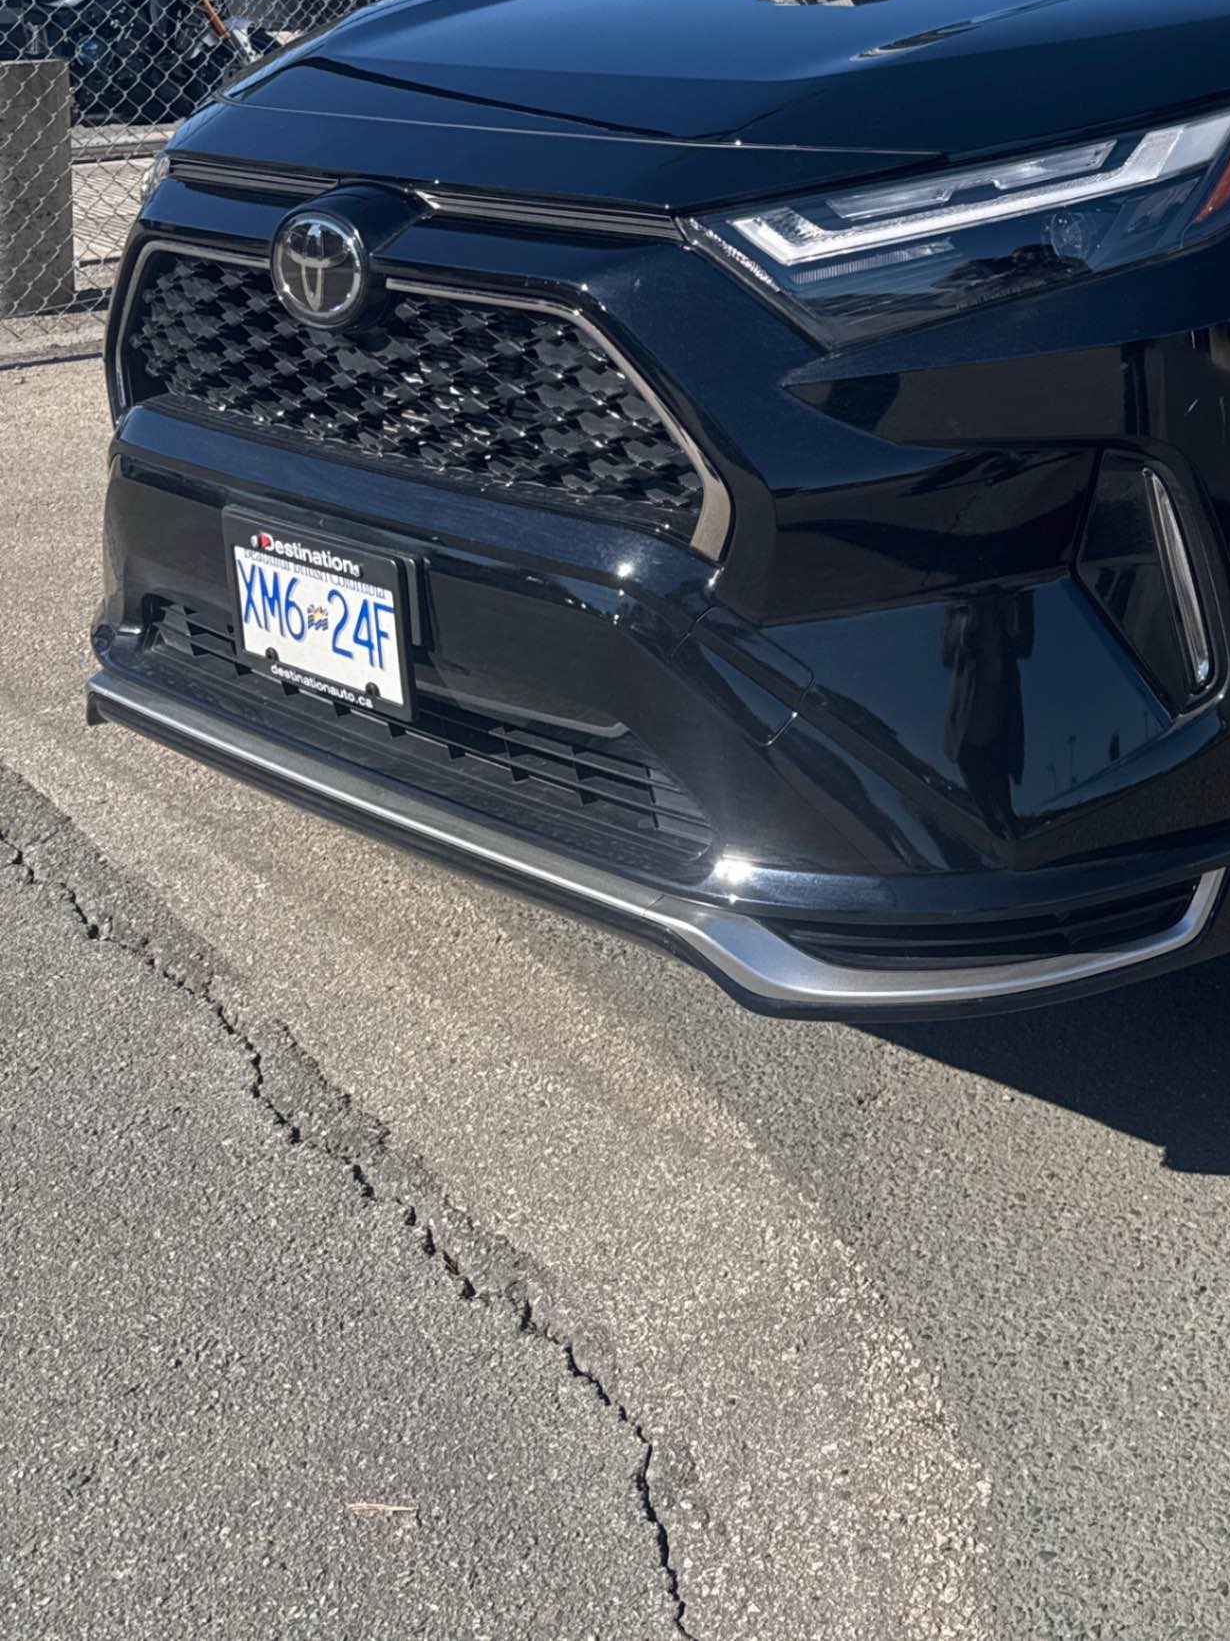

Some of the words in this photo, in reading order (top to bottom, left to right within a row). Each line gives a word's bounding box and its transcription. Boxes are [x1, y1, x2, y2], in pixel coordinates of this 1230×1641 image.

[237, 560, 305, 641] XM6
[328, 589, 394, 669] 24F
[271, 664, 374, 709] destinationauto.ca
